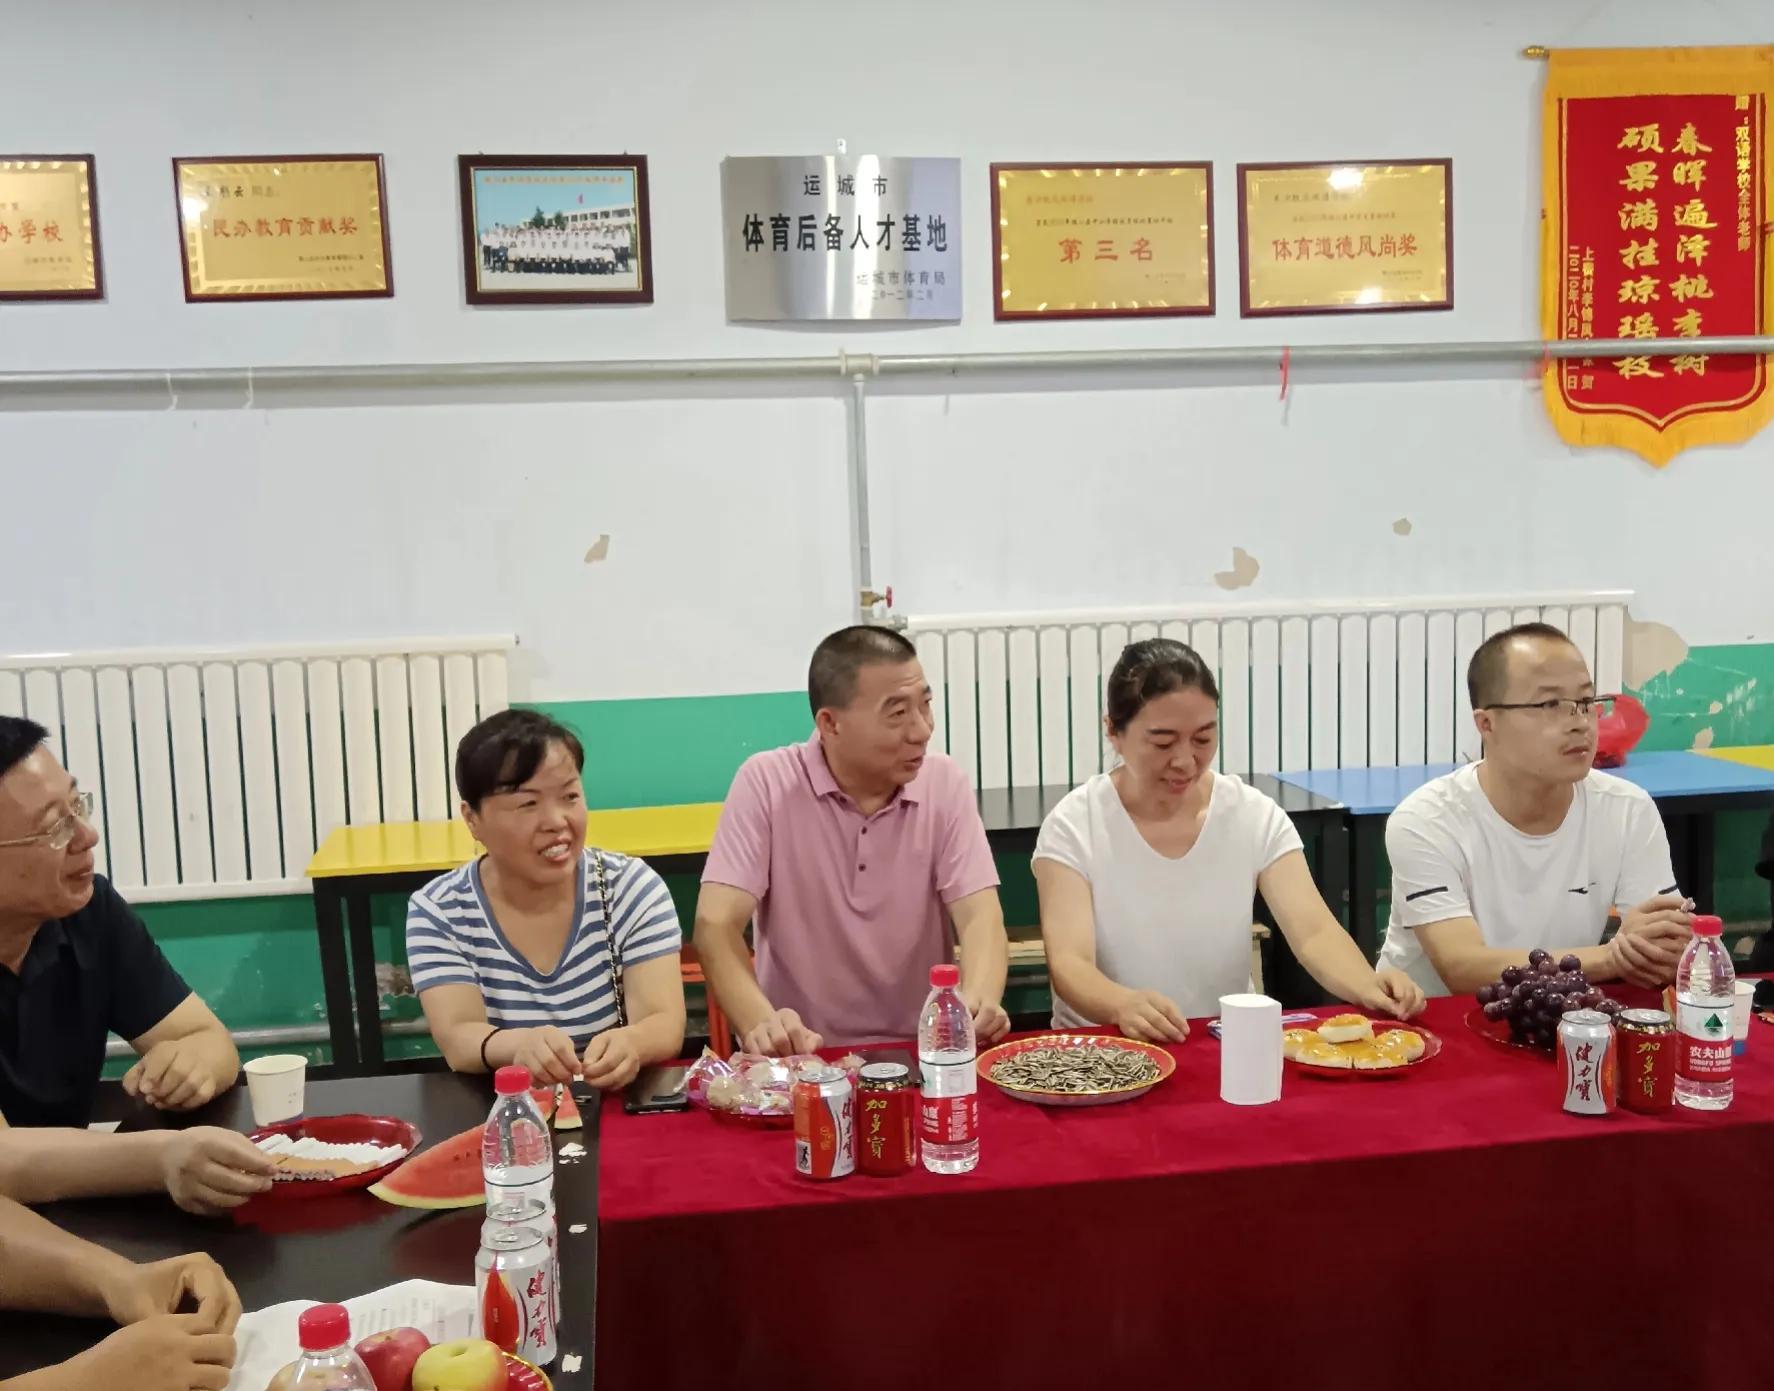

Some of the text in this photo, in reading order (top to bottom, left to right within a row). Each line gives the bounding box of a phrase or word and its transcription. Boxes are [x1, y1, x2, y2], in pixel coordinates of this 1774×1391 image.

[803, 174, 888, 196] 运城市
[213, 216, 358, 238] 民办教育贡献奖
[742, 213, 949, 252] 体育后备人才基地
[1058, 237, 1153, 264] 第三名
[1272, 232, 1418, 262] 体育道德风尚奖
